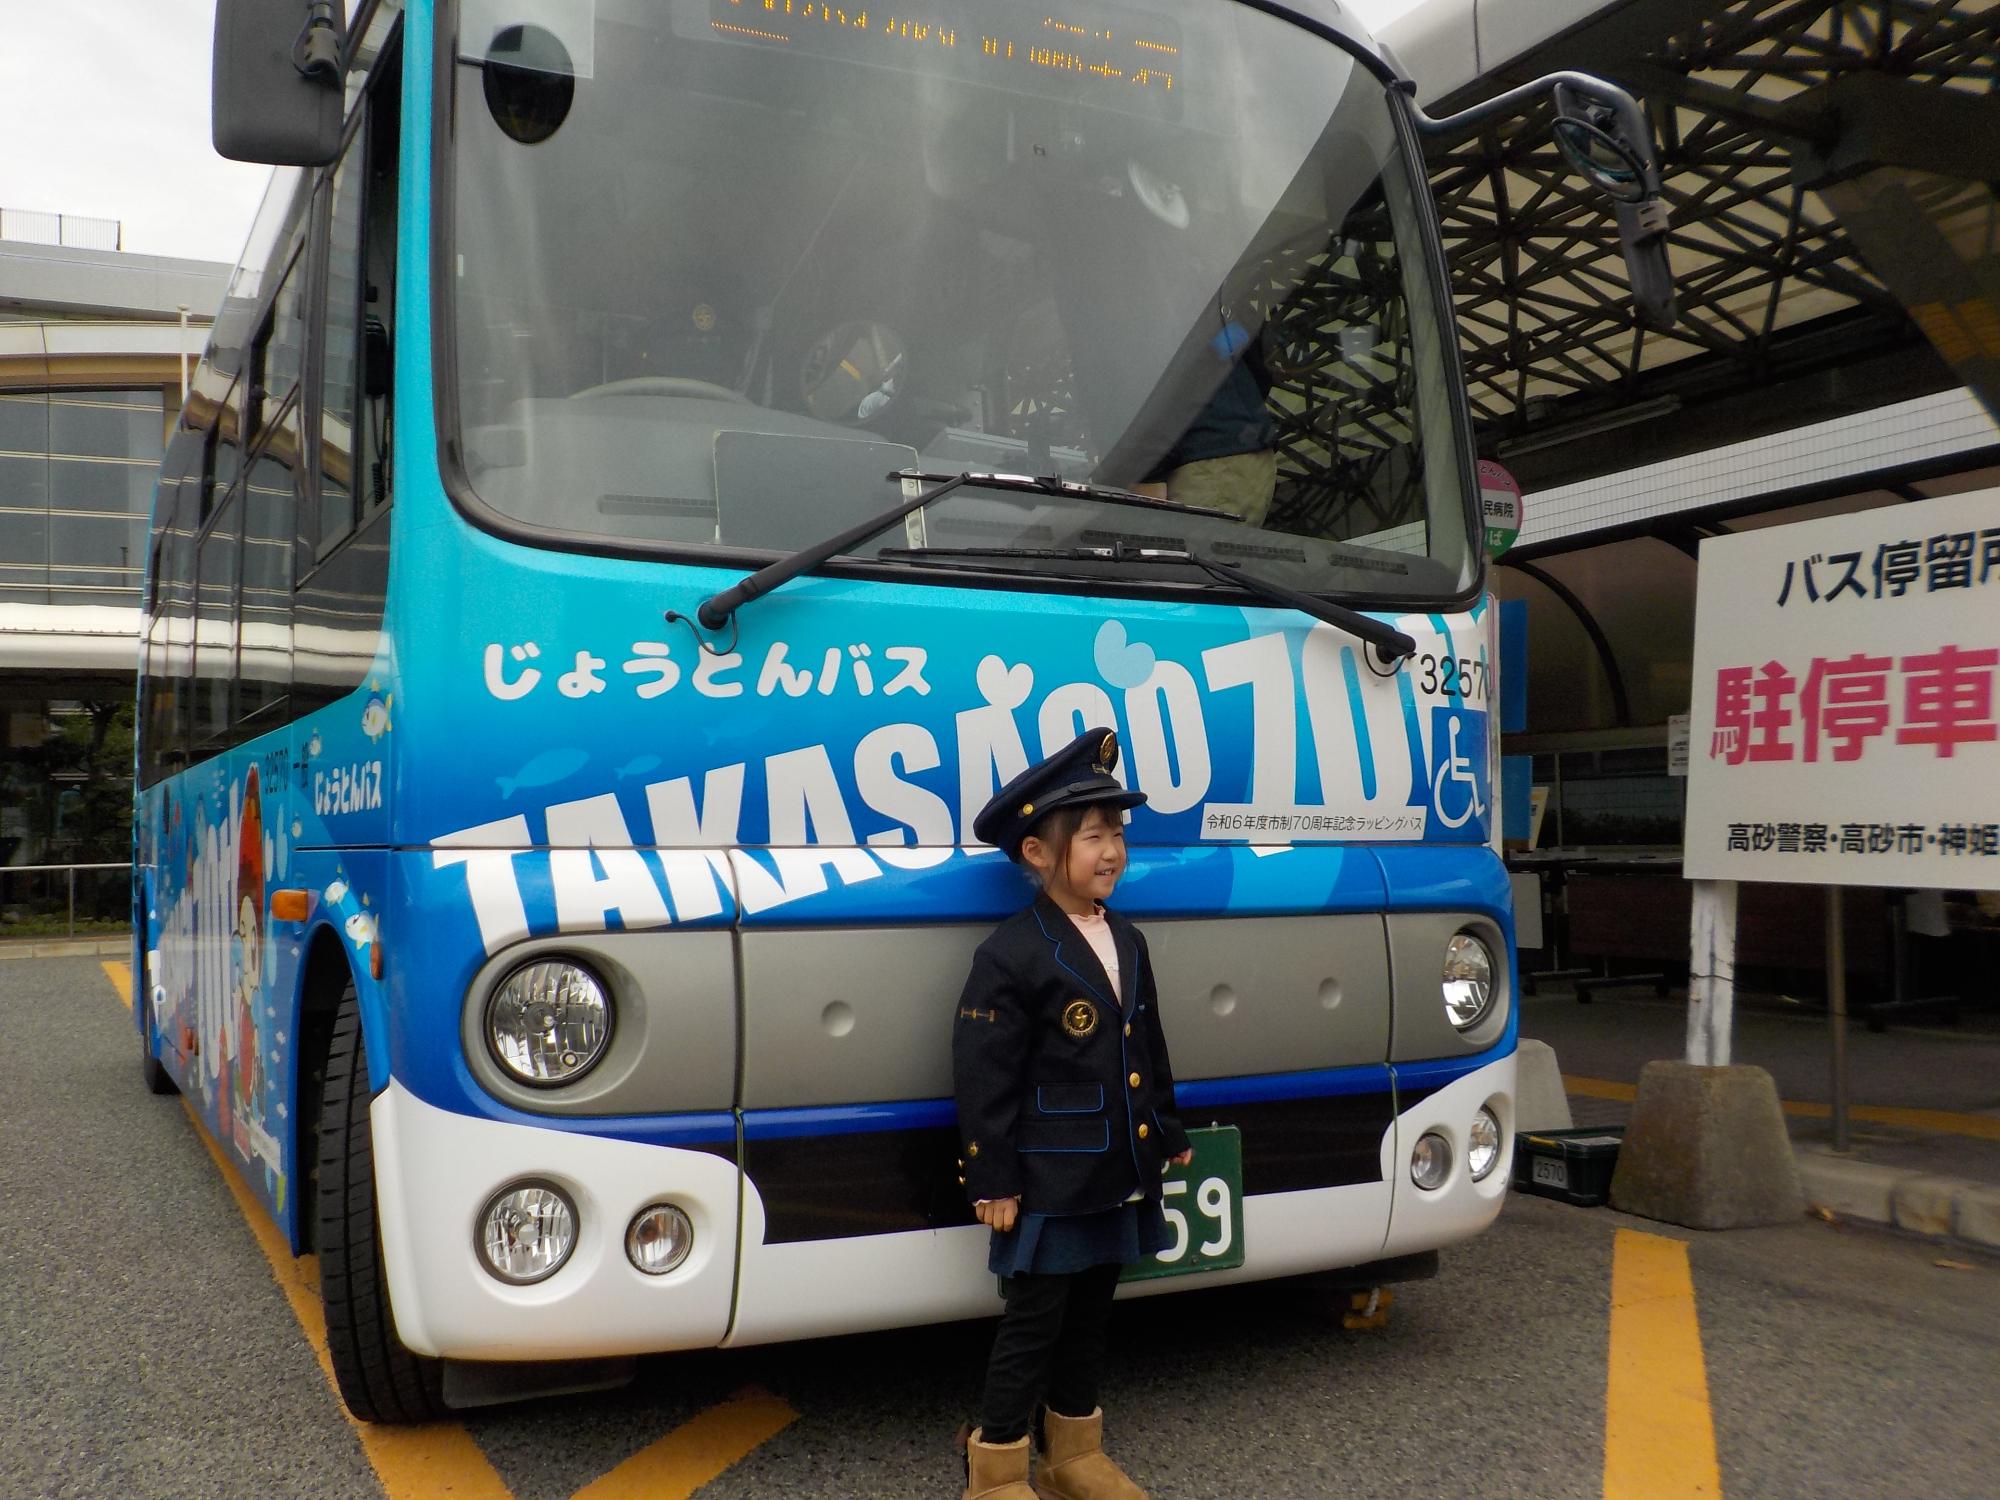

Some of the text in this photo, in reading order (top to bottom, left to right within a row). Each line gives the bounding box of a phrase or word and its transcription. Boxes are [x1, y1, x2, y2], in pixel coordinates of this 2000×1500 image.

[1484, 500, 1514, 518] 民病院
[483, 641, 931, 700] じょうとんバス
[1709, 644, 1999, 766] 駐停車
[315, 760, 382, 816] じょうとんバス
[1206, 814, 1423, 831] 令和6年度市制70周年記念ラッピングバス
[1537, 1162, 1565, 1182] 2570
